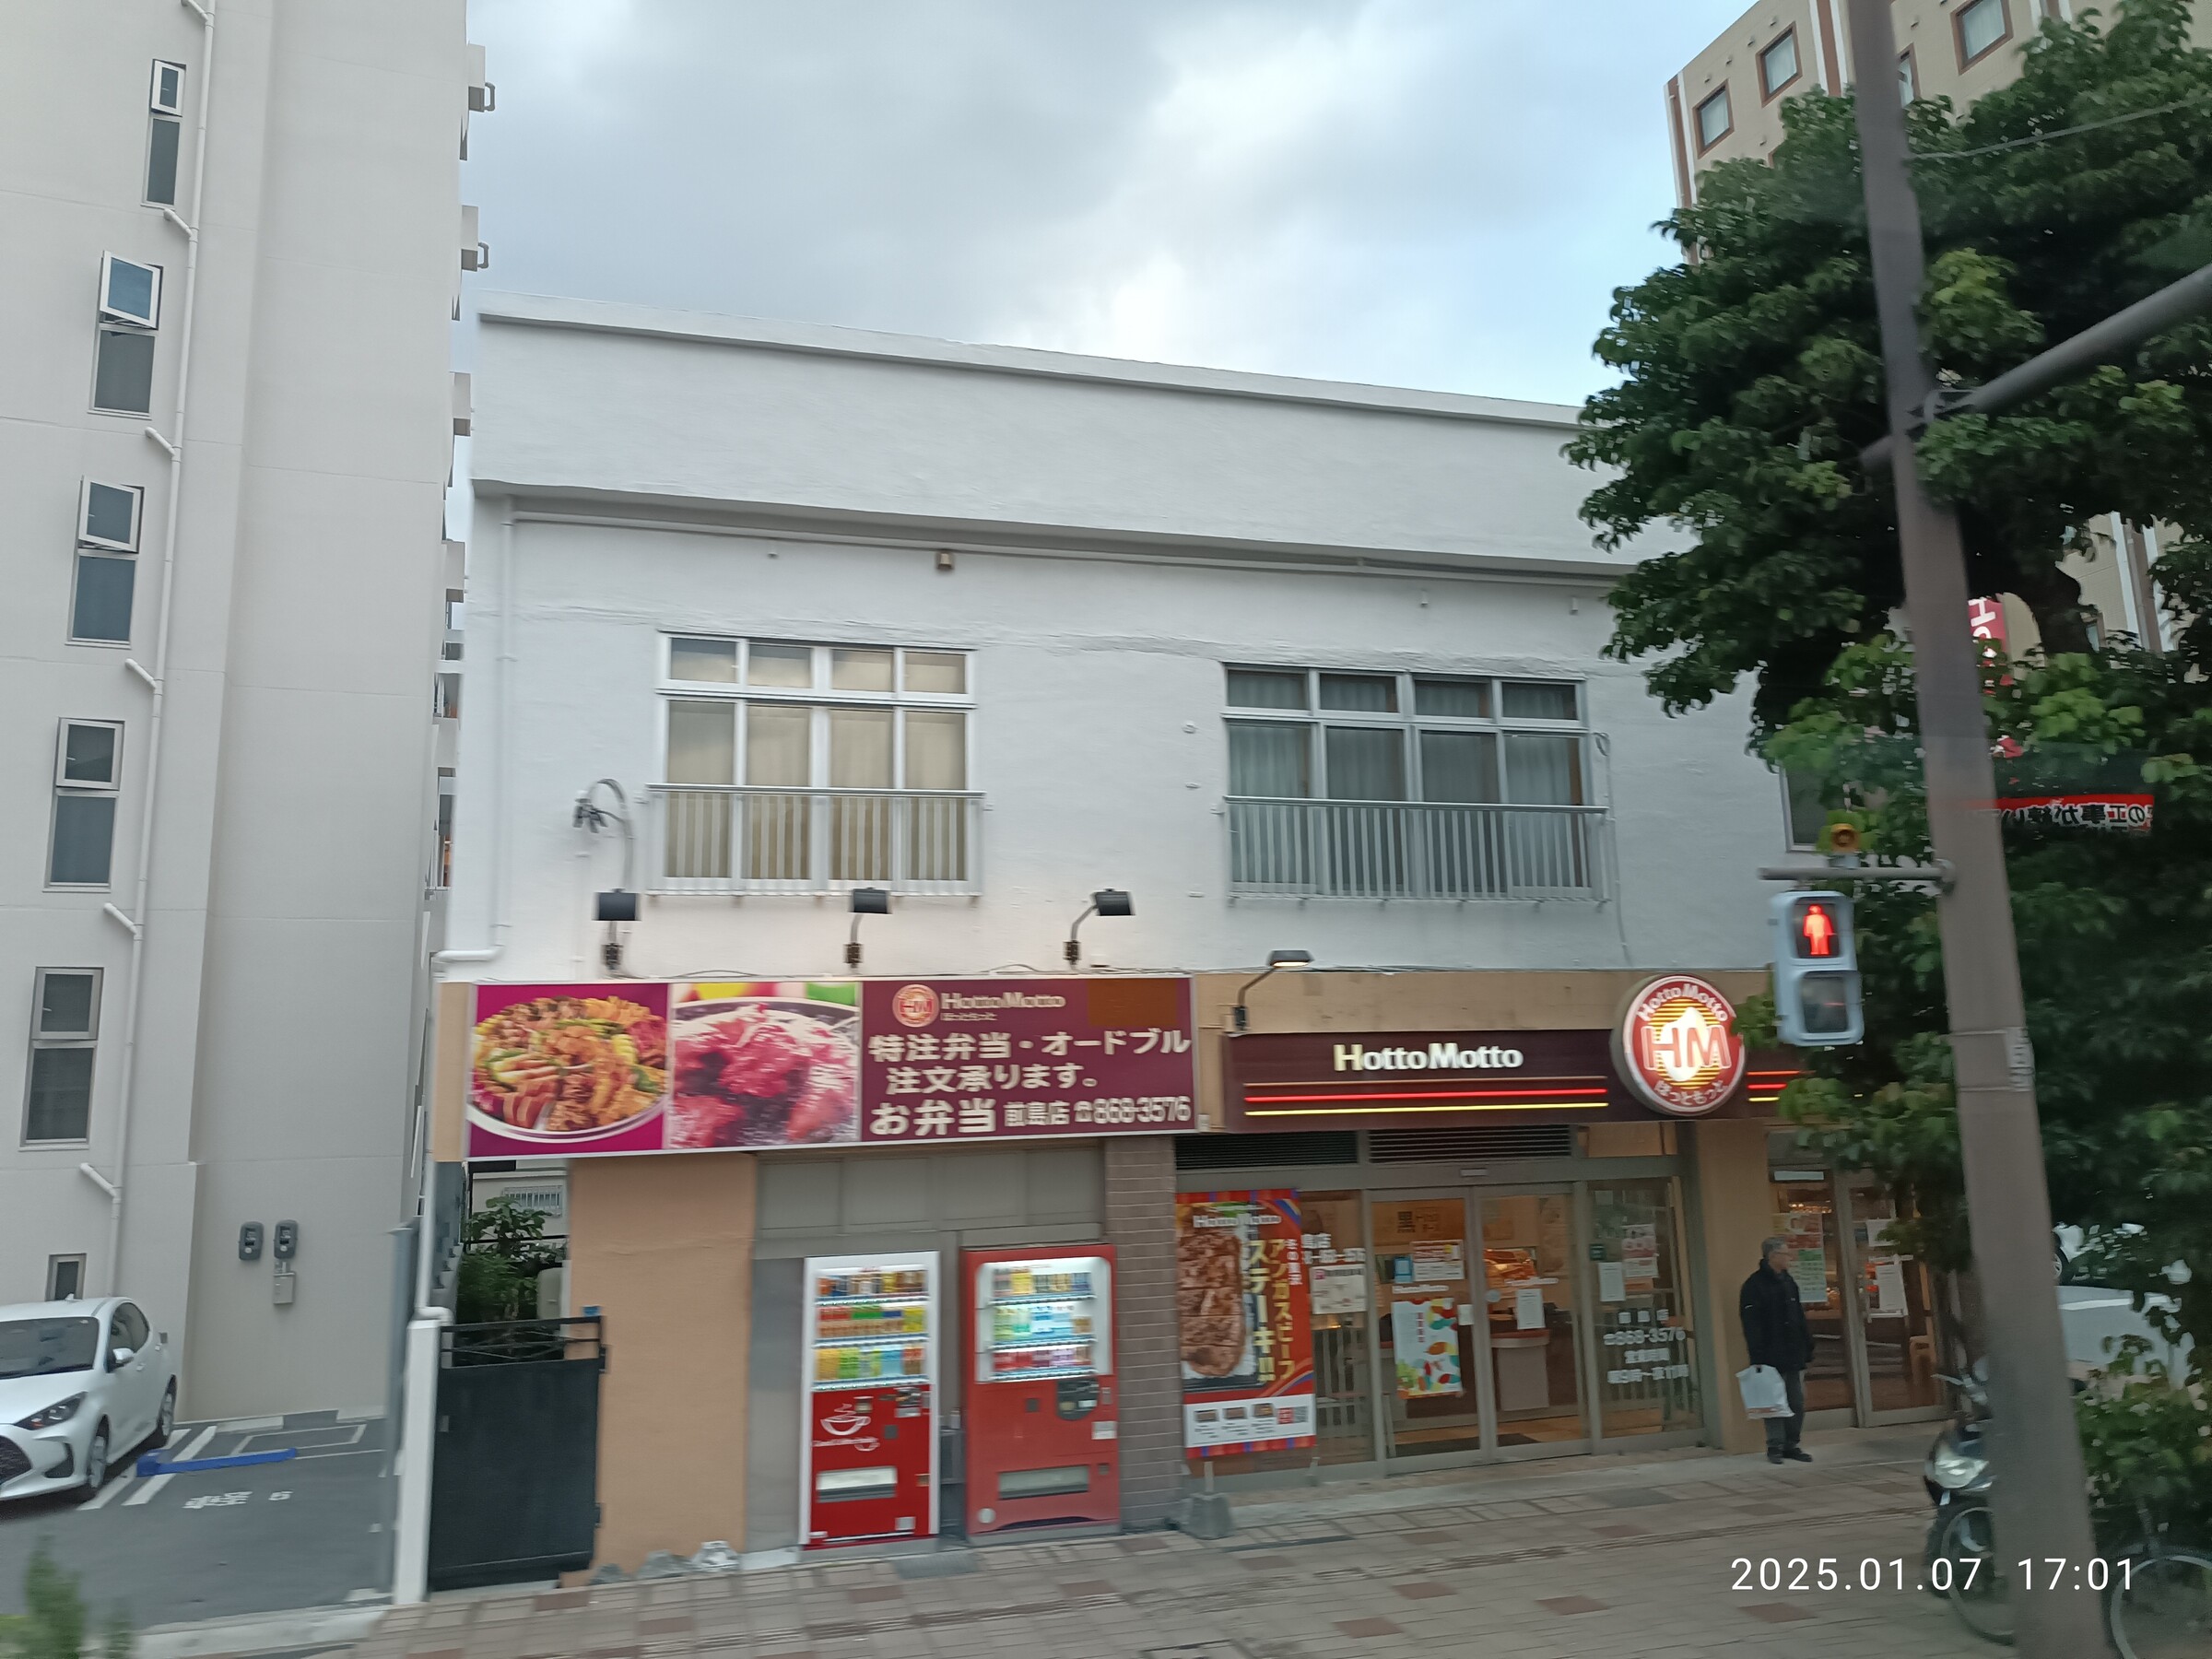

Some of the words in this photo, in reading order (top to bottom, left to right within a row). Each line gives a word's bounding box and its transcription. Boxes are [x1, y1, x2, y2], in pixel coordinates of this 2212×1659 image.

[1637, 983, 1728, 1021] HottoMotto
[867, 1027, 1192, 1062] 特注弁当・オードブル
[1334, 1042, 1524, 1071] HottoMotto
[1641, 1025, 1732, 1070] HM
[886, 1063, 1098, 1095] 注文承ります。
[869, 1098, 998, 1136] お弁当
[1003, 1100, 1071, 1126] 前島店
